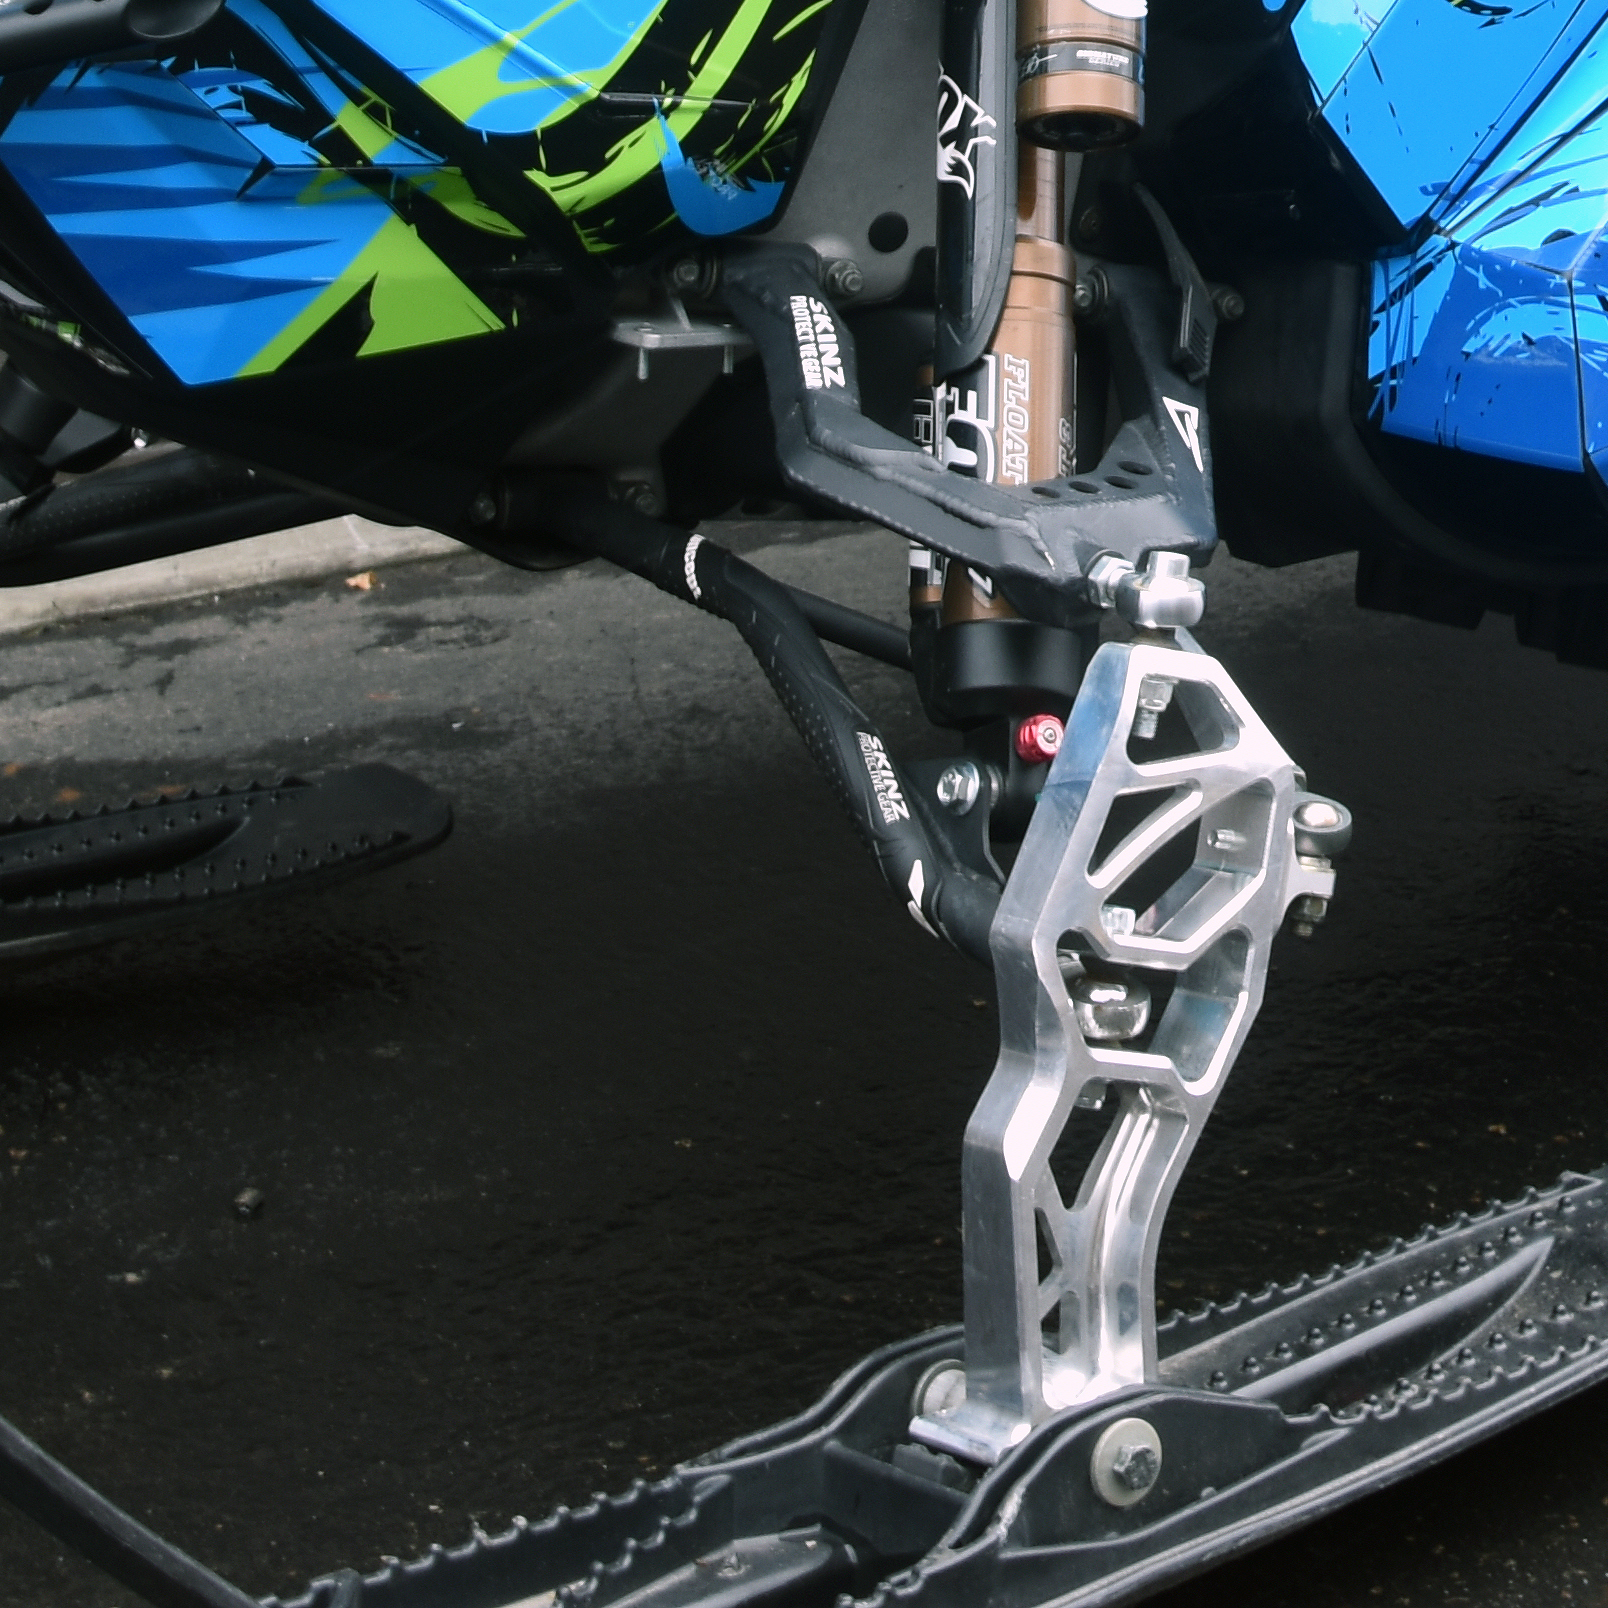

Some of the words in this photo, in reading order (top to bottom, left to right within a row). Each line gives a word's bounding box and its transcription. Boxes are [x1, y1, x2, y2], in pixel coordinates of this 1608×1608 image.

[809, 297, 846, 389] SKINZ
[1003, 353, 1031, 488] FLOAT
[868, 734, 911, 821] SKINZ
